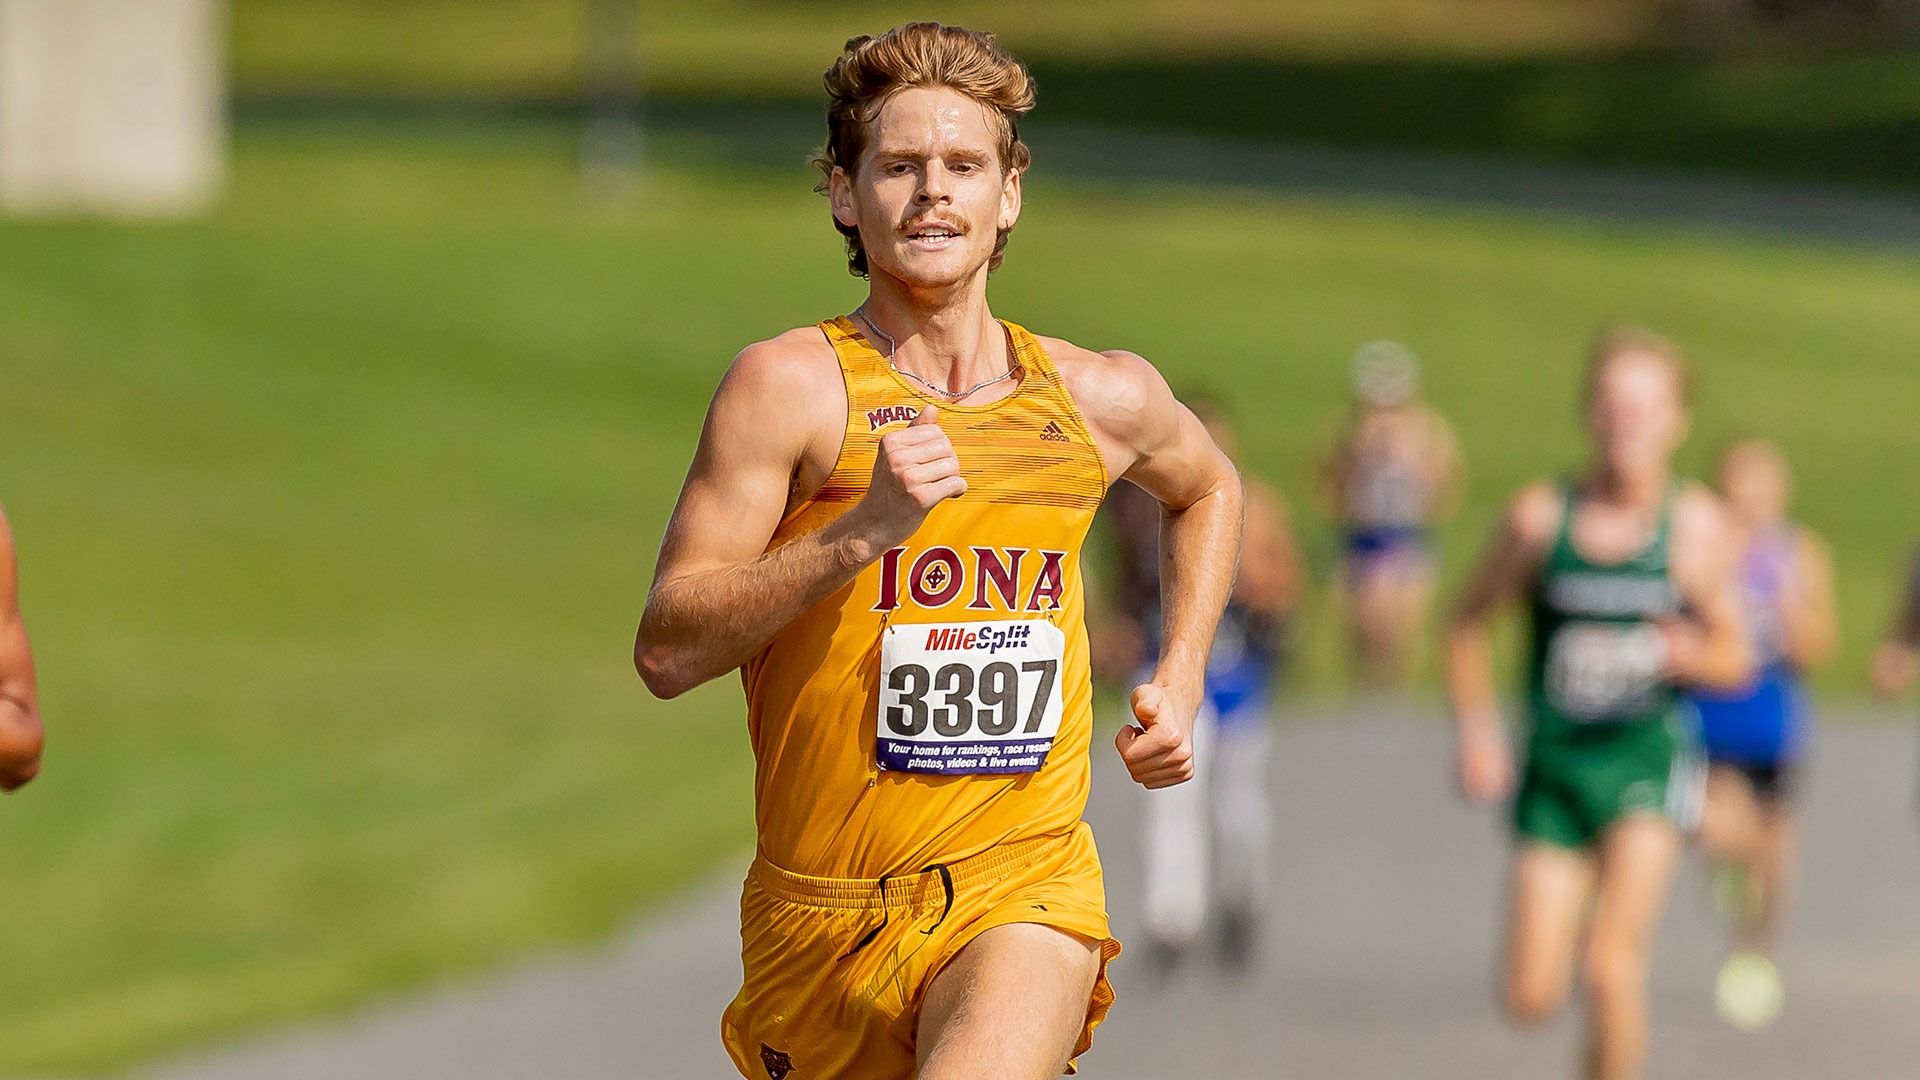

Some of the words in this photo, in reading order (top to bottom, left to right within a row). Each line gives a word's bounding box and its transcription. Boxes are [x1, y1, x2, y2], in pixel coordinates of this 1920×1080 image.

[867, 406, 919, 432] MAAC
[1039, 432, 1070, 443] adidas
[869, 545, 1068, 612] IONA
[925, 625, 1030, 654] MileSplit
[886, 659, 1058, 737] 3397
[888, 742, 911, 754] Your
[912, 745, 940, 756] home
[941, 745, 957, 756] for
[957, 745, 1001, 757] rankings,
[1003, 745, 1024, 755] race
[907, 757, 945, 771] photos,
[946, 757, 978, 769] videos
[979, 756, 988, 767] &
[989, 756, 1008, 768] live
[1008, 756, 1039, 767] events
